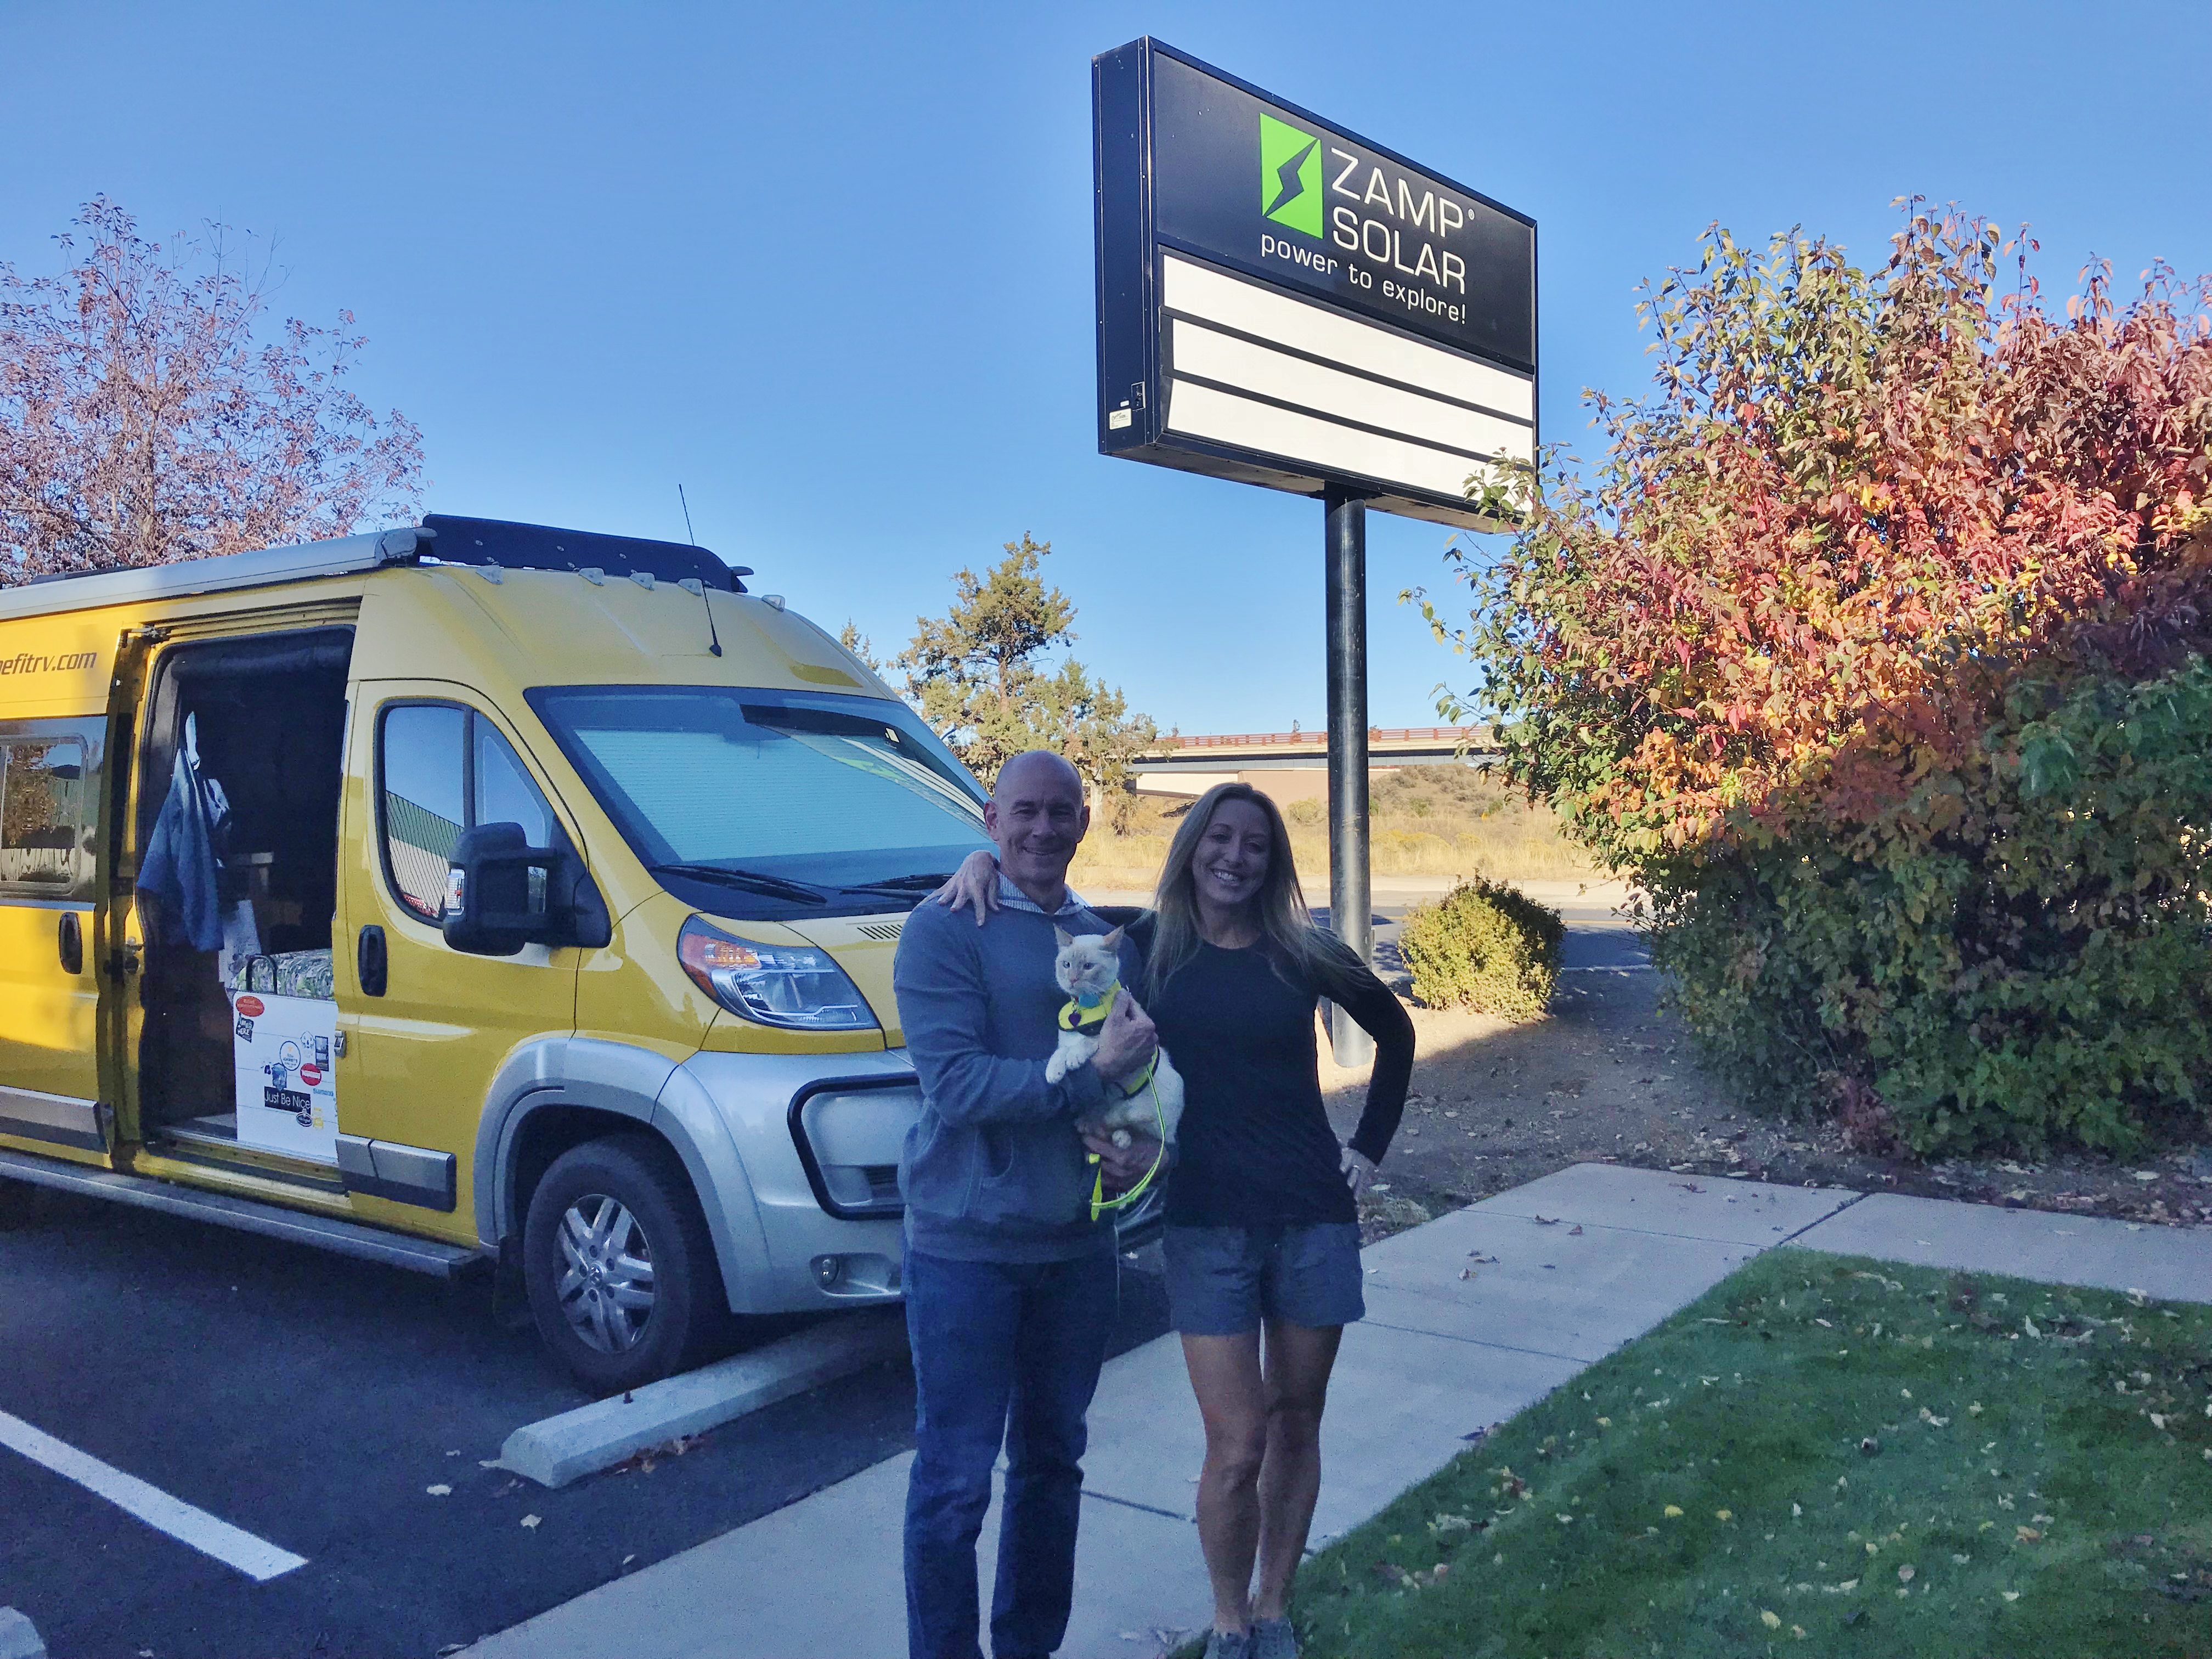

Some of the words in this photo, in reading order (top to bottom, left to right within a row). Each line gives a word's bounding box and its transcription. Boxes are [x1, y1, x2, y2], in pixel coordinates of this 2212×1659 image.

[1261, 233, 1338, 274] power
[1348, 263, 1372, 289] to
[1383, 279, 1466, 324] explore!
[1333, 206, 1465, 295] SOLAR
[264, 1090, 279, 1103] Just
[281, 1093, 291, 1106] Be
[292, 1095, 311, 1109] Nice
